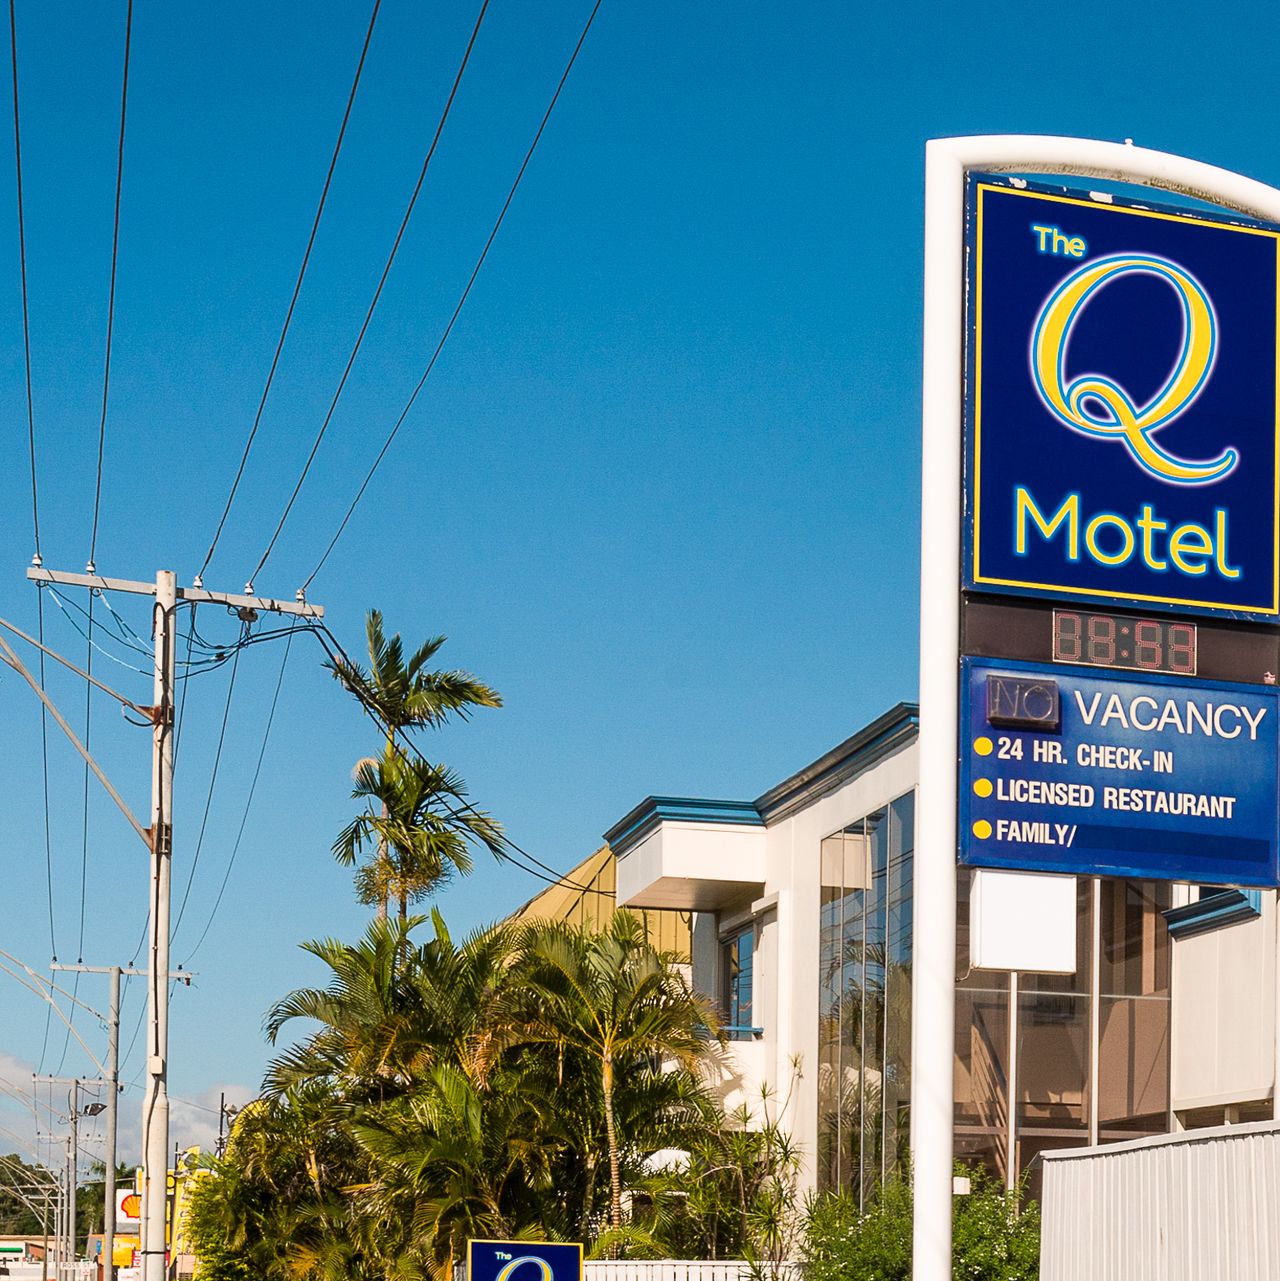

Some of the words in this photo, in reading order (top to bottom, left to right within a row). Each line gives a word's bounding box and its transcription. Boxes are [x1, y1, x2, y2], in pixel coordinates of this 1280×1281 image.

[1033, 226, 1085, 256] The
[1032, 254, 1238, 483] Q
[1015, 487, 1240, 577] Motel
[993, 679, 1053, 720] NO
[1074, 690, 1267, 740] VACANCY
[997, 736, 1024, 761] 24
[1033, 739, 1068, 764] HR.
[1076, 743, 1173, 774] CHECK-IN
[997, 778, 1095, 808] LICENSED
[1103, 786, 1236, 819] RESTAURANT
[996, 819, 1077, 848] FAMILY/
[495, 1251, 512, 1260] The
